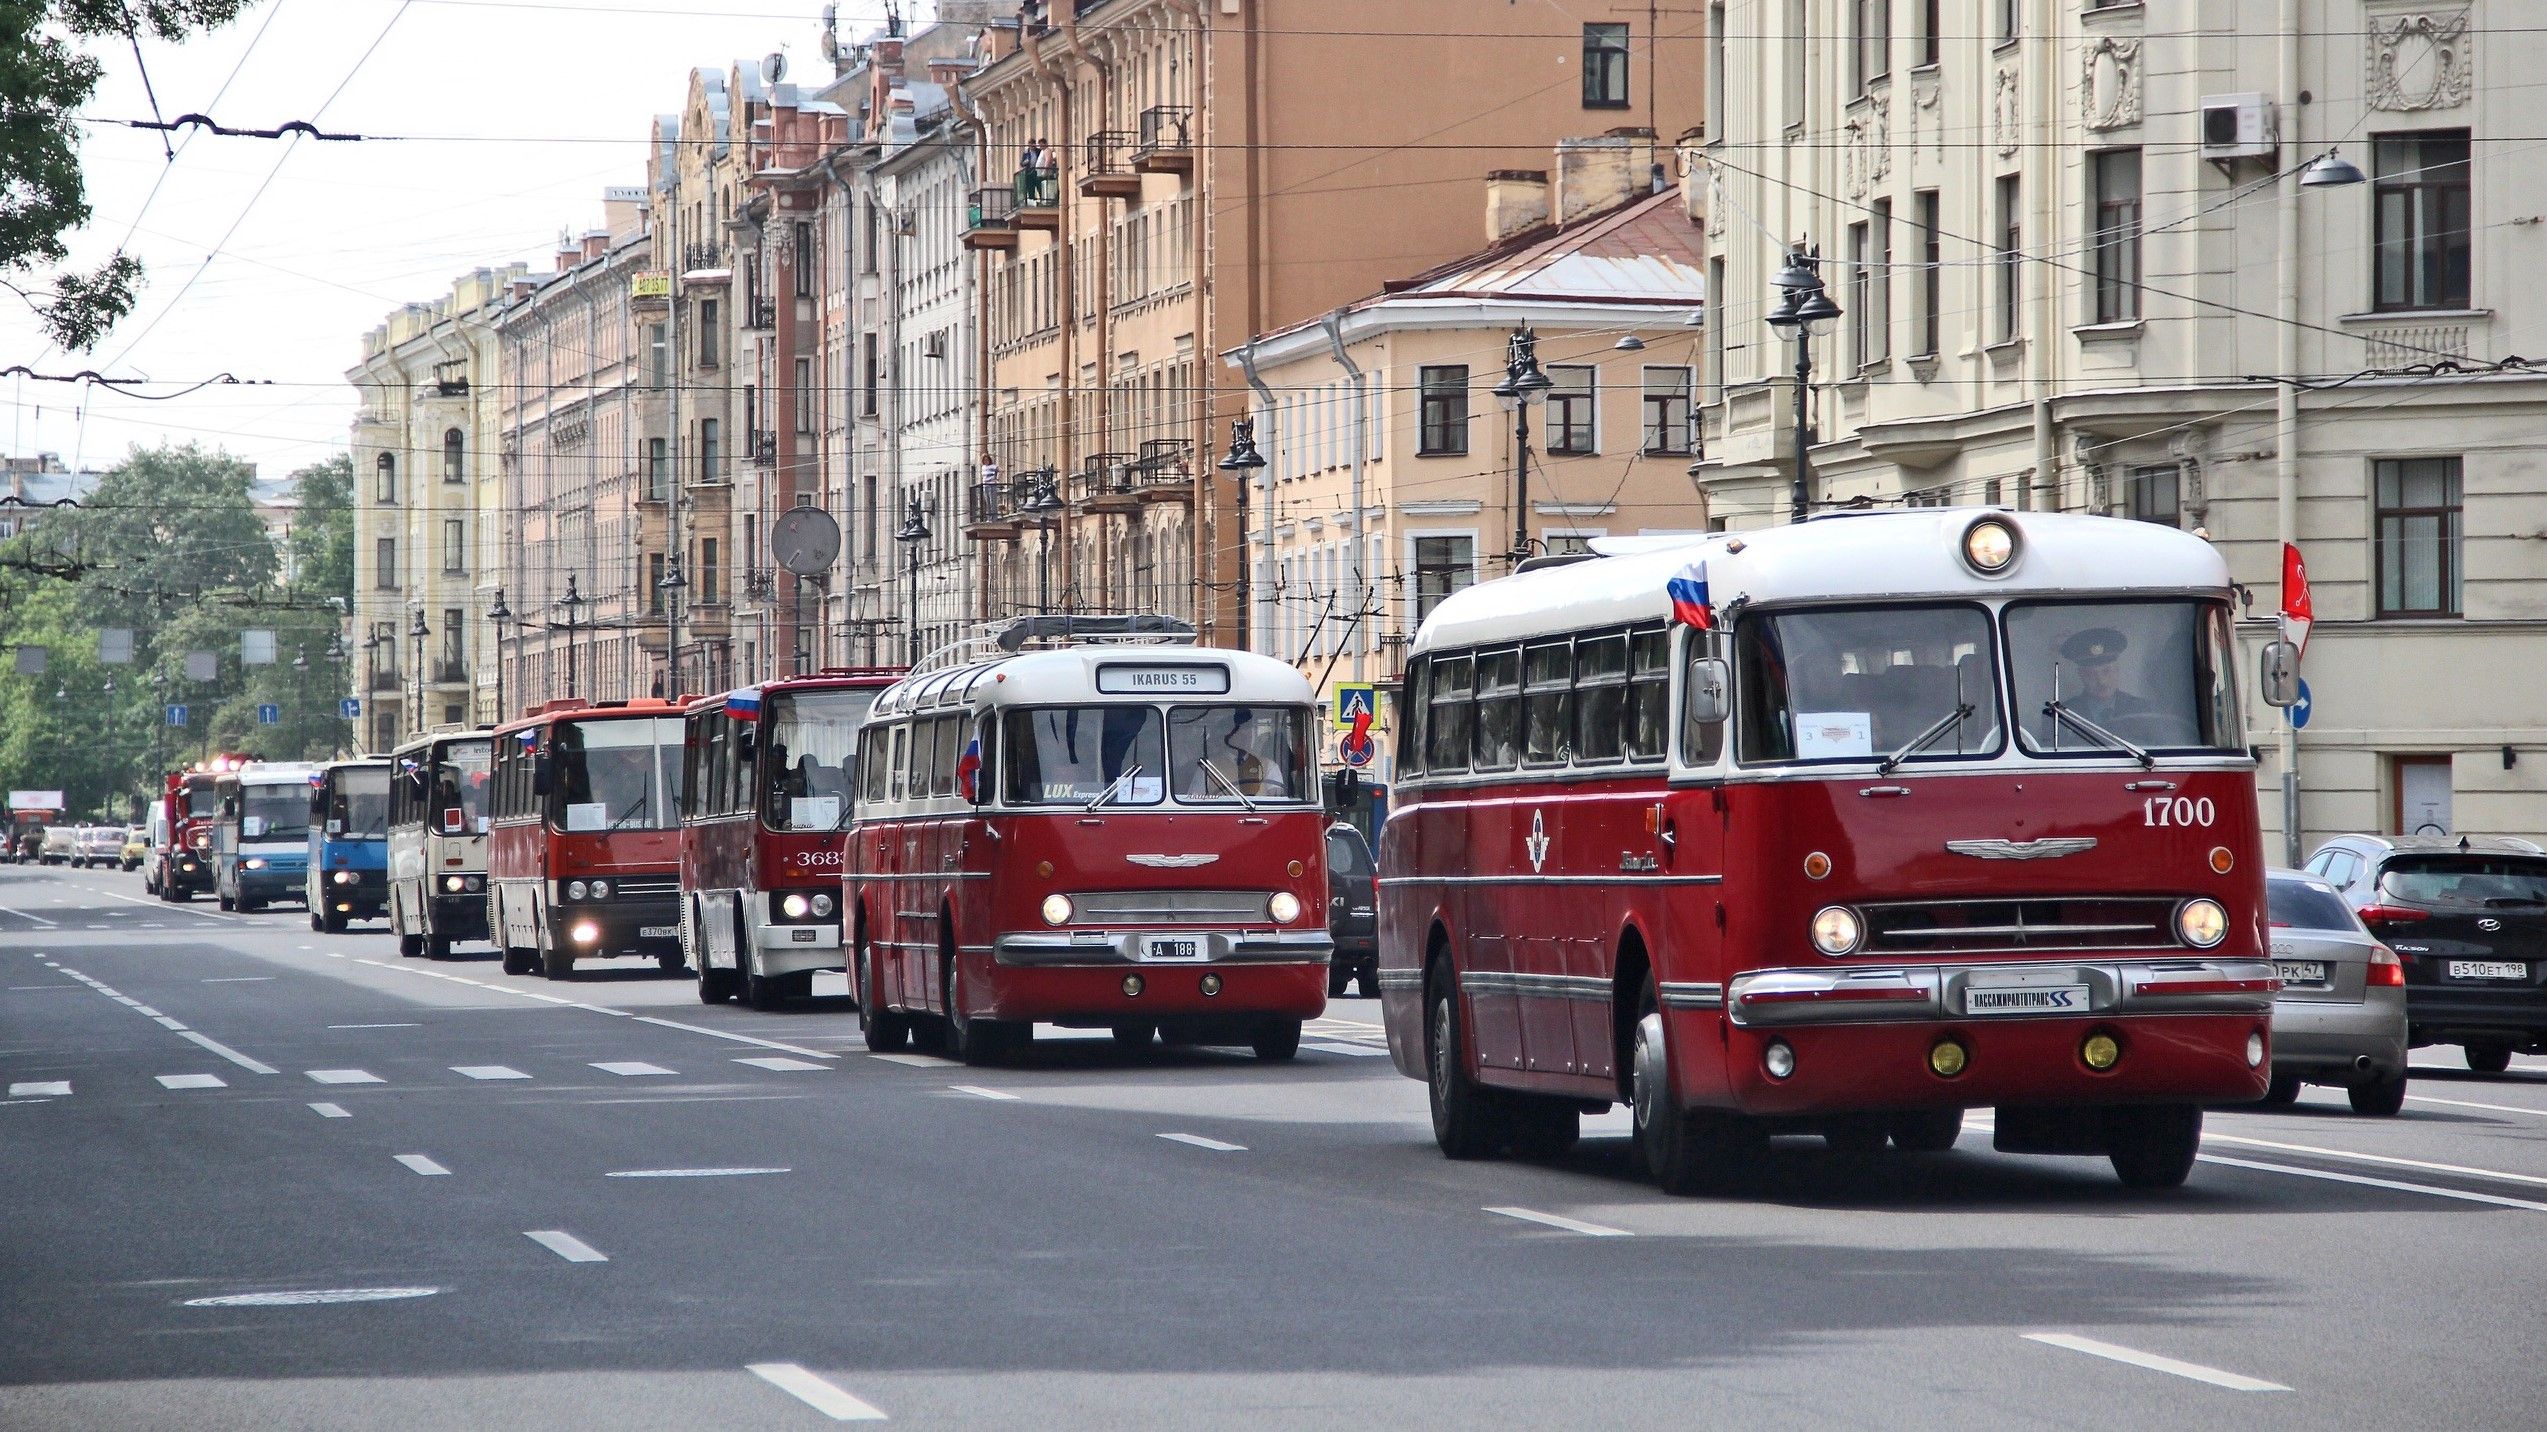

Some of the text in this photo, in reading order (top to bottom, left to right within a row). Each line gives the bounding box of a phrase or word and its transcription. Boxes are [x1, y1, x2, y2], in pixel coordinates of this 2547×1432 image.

[1132, 674, 1197, 686] IKARUS 55
[1043, 784, 1073, 799] LUX
[2144, 797, 2215, 827] 1700
[1174, 943, 1192, 956] 188
[2304, 962, 2319, 975] 47
[2505, 963, 2523, 974] 198
